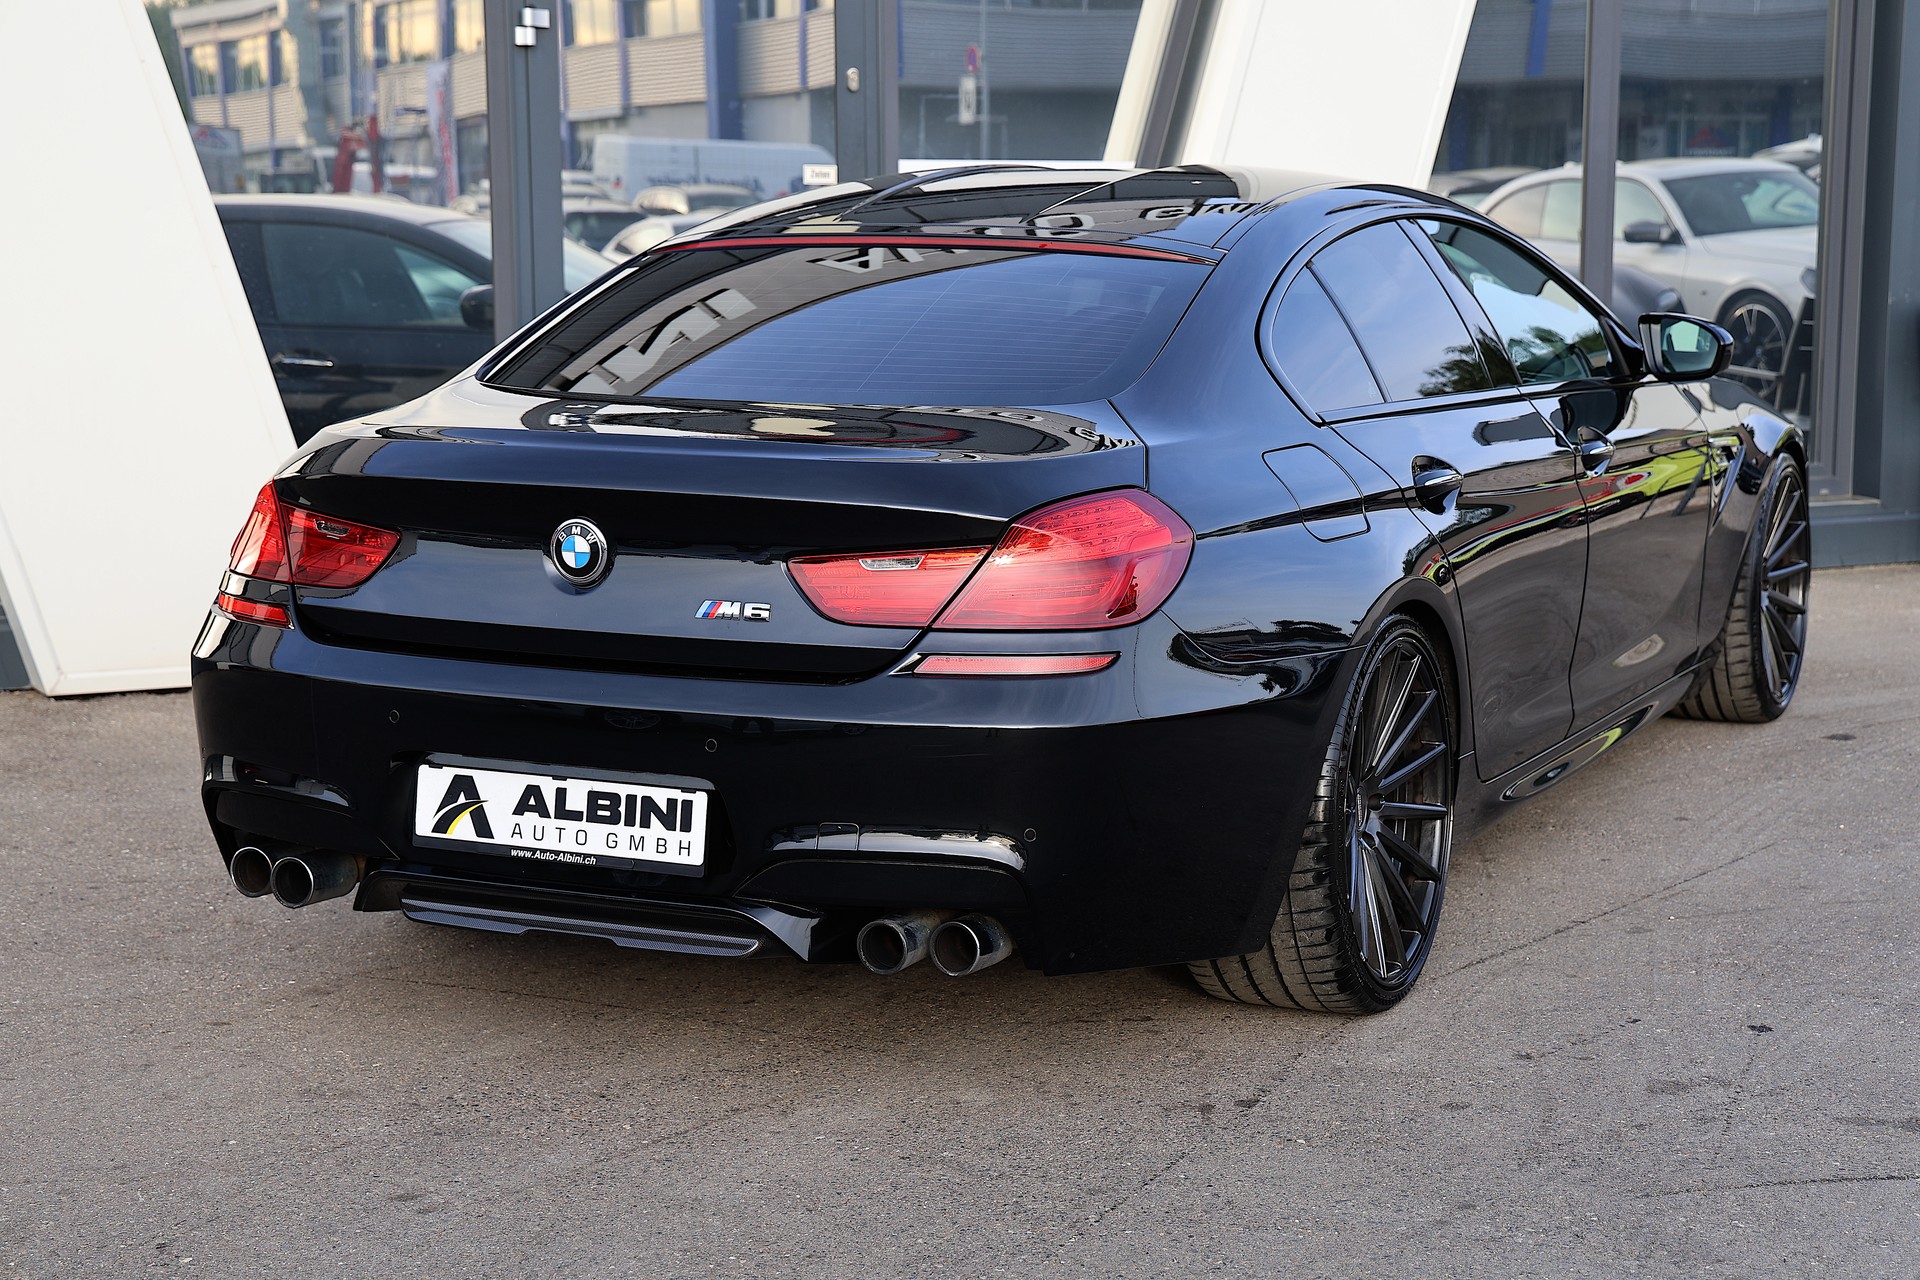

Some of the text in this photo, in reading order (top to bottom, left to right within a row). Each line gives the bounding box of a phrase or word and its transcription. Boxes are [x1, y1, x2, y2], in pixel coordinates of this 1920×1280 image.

[558, 525, 598, 544] BMW
[511, 783, 694, 834] ALBINI
[510, 822, 692, 857] AUTO GMBH
[510, 848, 597, 866] www.Auto-Albini.ch
